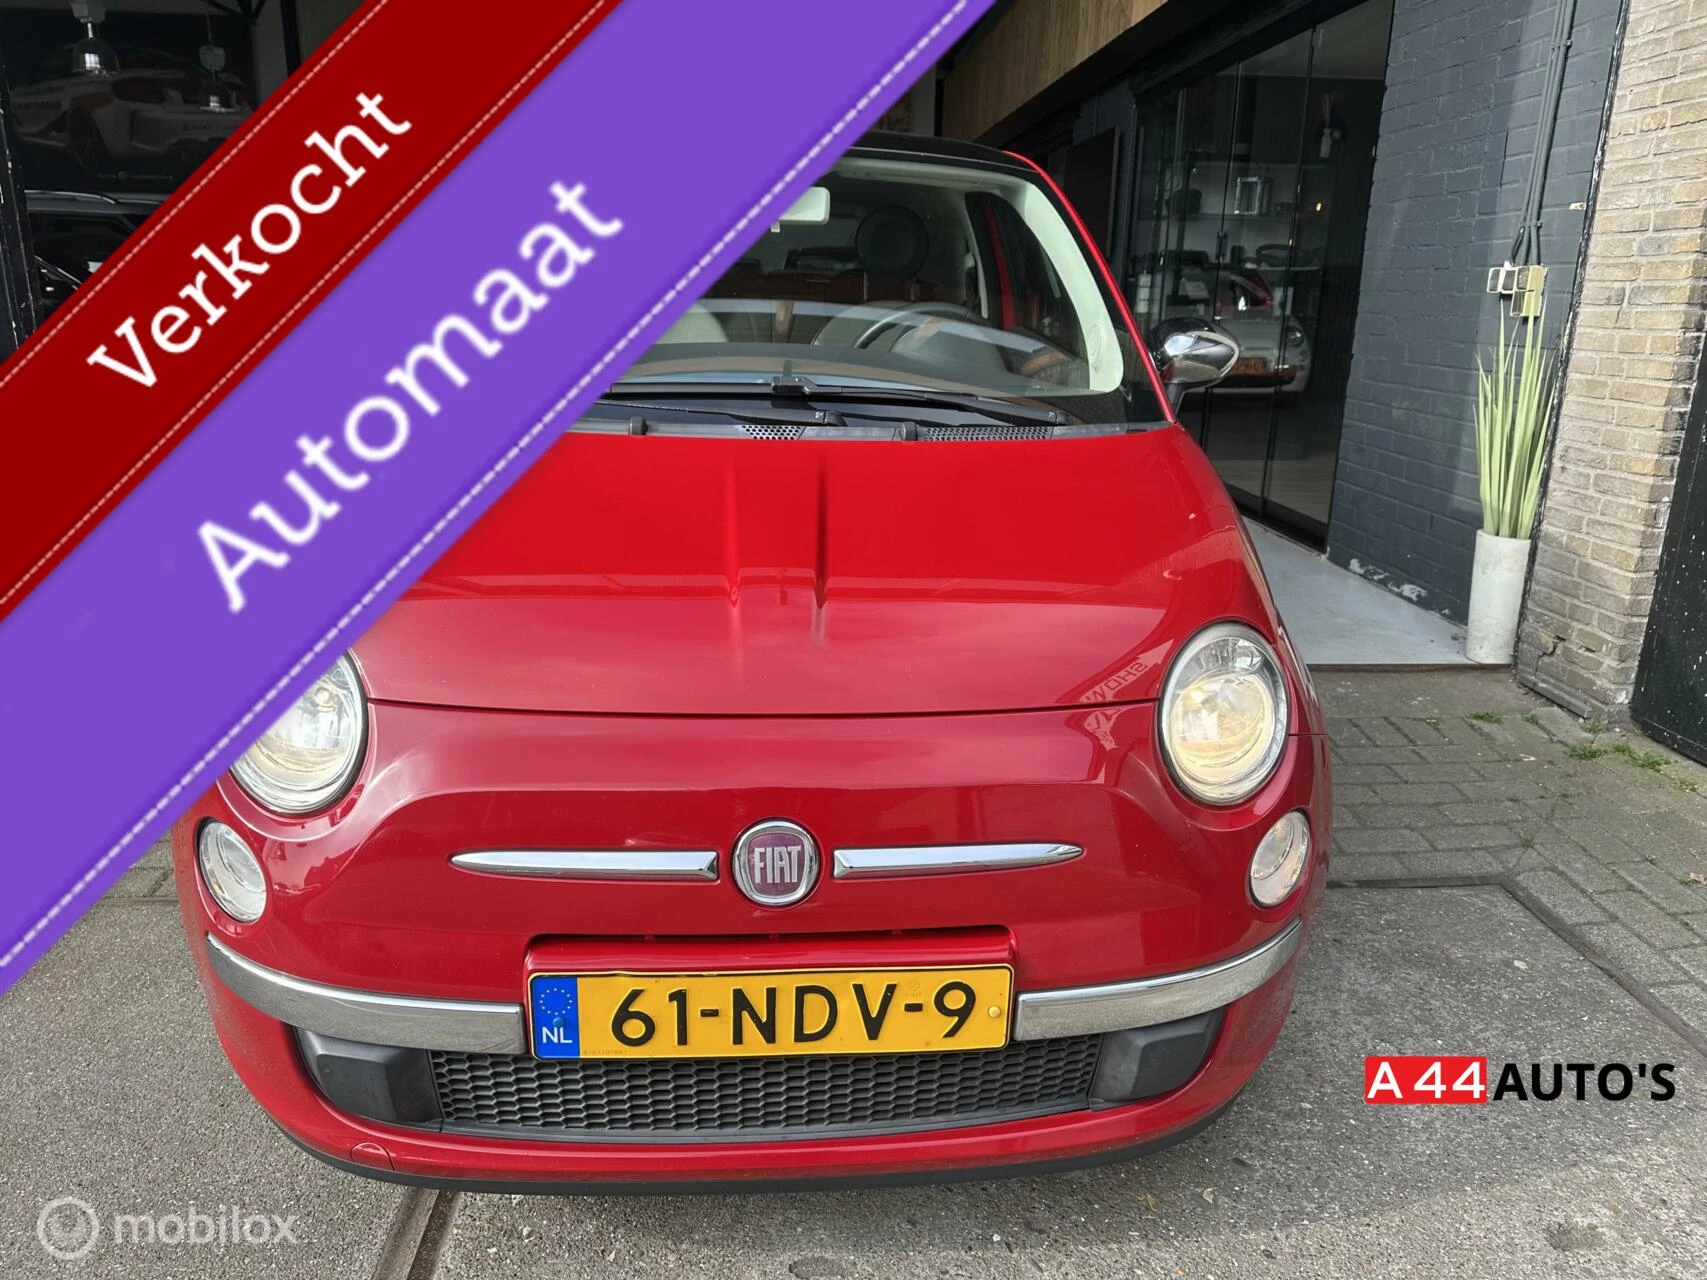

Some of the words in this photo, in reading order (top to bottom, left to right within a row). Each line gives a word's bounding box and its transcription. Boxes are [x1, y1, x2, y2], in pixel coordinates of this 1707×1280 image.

[754, 845, 802, 884] FIAT
[611, 980, 977, 1047] 61-NDV-9
[542, 1026, 573, 1044] NL
